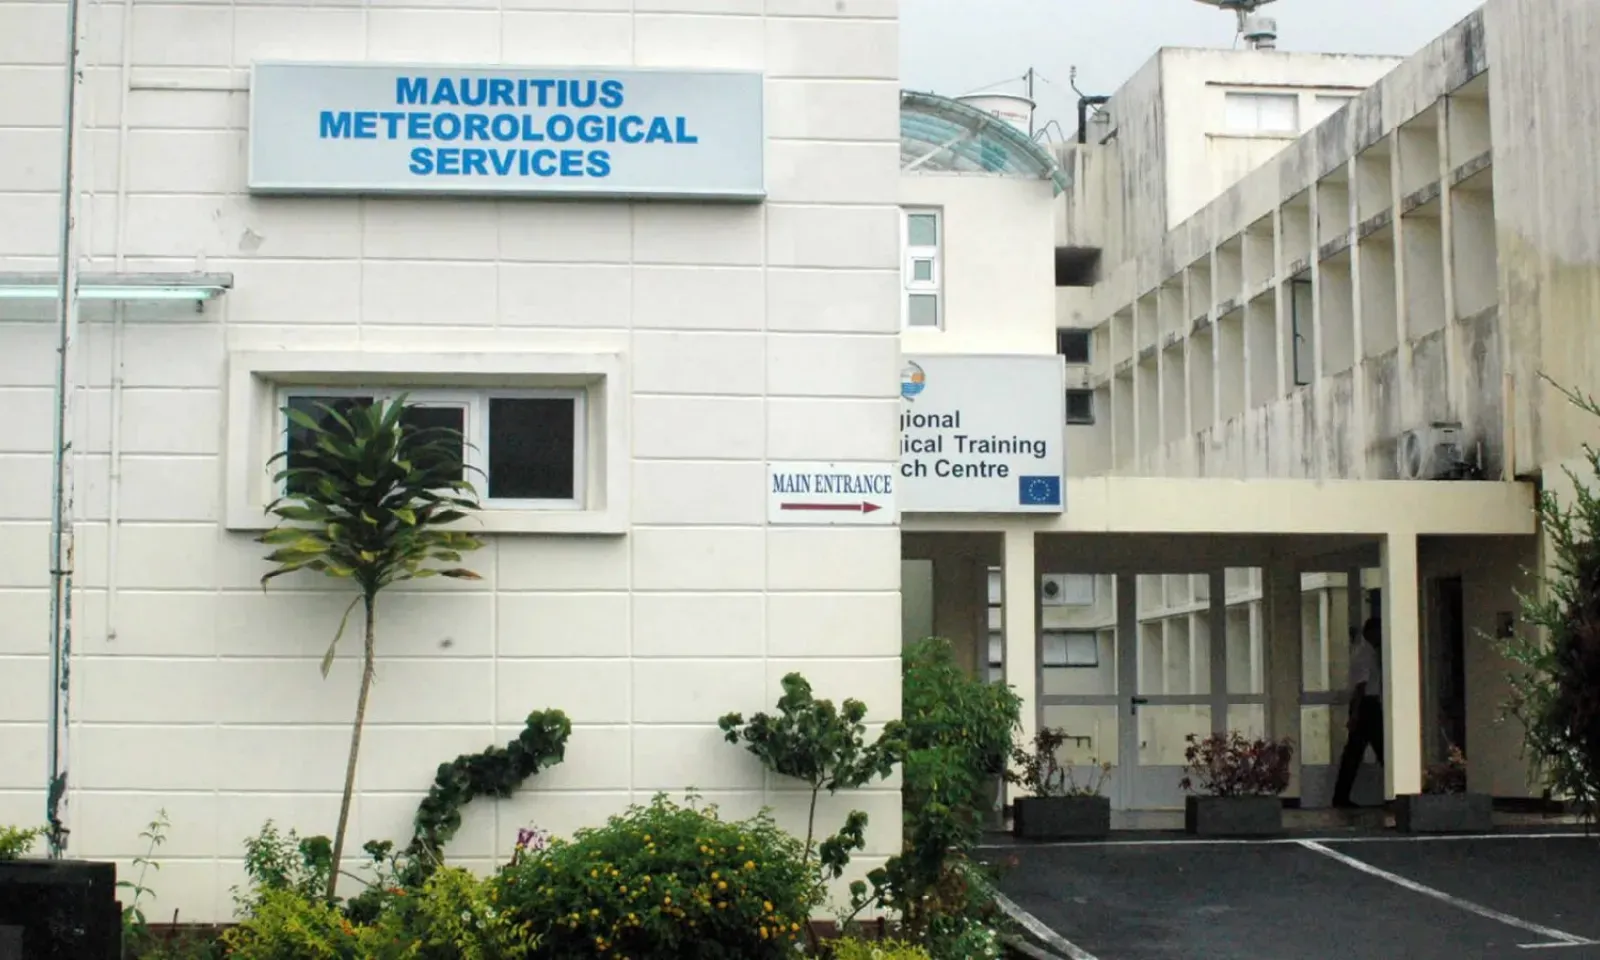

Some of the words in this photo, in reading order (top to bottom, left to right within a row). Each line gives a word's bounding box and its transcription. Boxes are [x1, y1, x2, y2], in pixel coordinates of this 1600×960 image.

[396, 77, 624, 108] MAURITIUS
[319, 111, 698, 143] METEOROLOGICAL
[408, 147, 611, 177] SERVICES
[900, 434, 942, 456] ical
[954, 435, 1046, 458] Training
[934, 459, 1009, 478] Centre
[772, 473, 811, 493] MAIN
[815, 474, 892, 494] ENTRANCE
